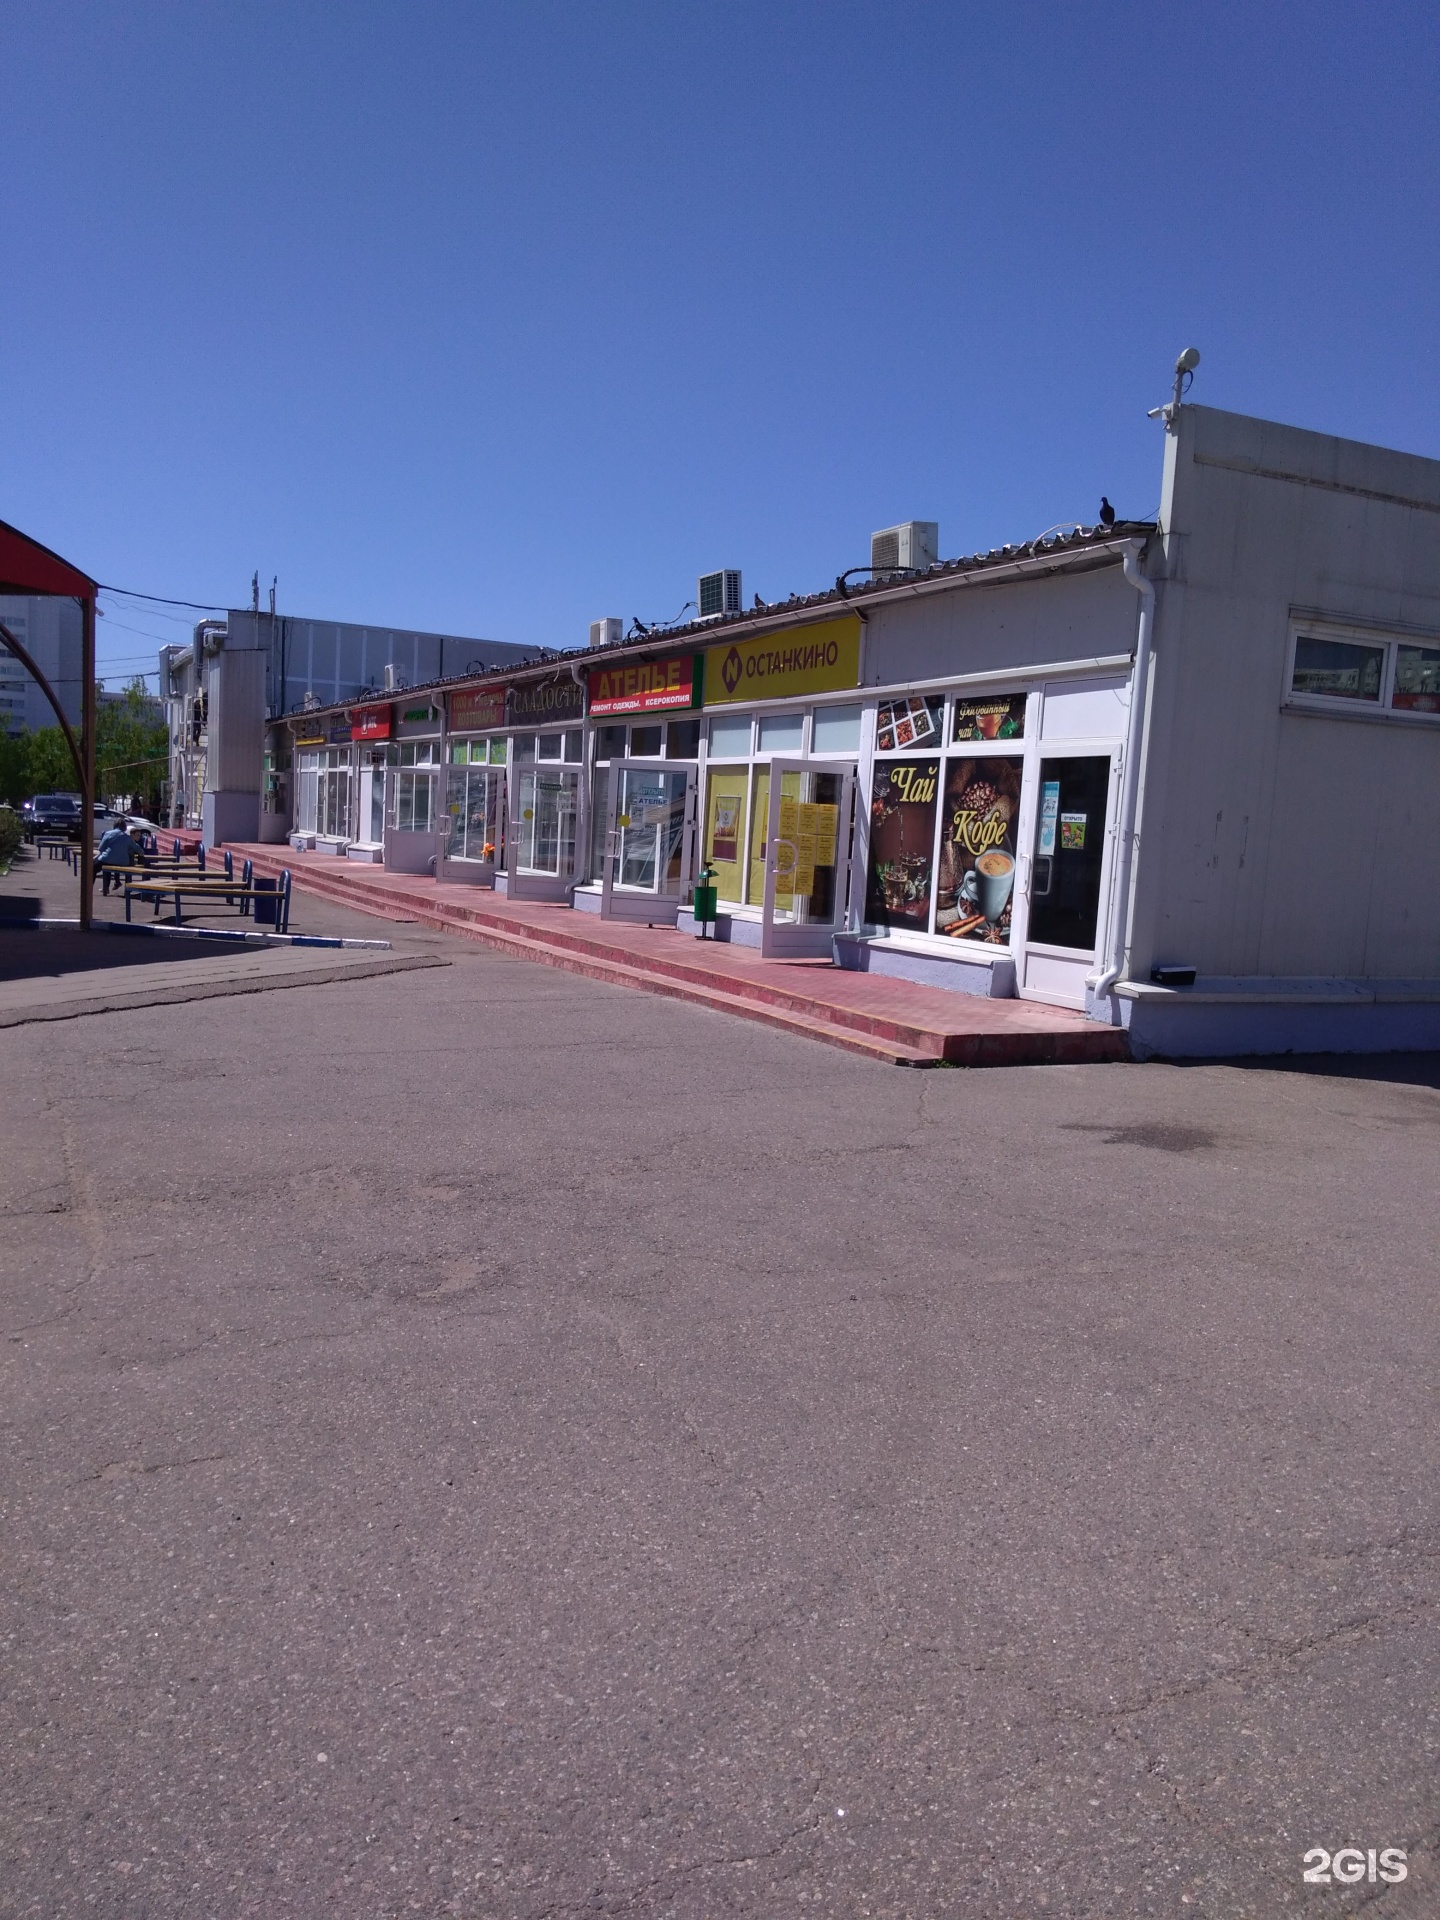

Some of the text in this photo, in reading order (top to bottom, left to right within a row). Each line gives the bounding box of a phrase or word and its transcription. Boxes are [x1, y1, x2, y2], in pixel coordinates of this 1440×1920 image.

[746, 641, 838, 678] ОСТАНКИНО
[598, 660, 681, 699] АТЕЛЬЕ
[457, 709, 497, 726] ХОЗТОВАРЫ
[514, 684, 582, 714] СЛАДОСТИ
[590, 694, 690, 712] РЕМОНТ ОДЕЖДЫ. КСЕРОКОПИЯ
[890, 766, 938, 803] Чай
[953, 810, 1007, 855] Кофе
